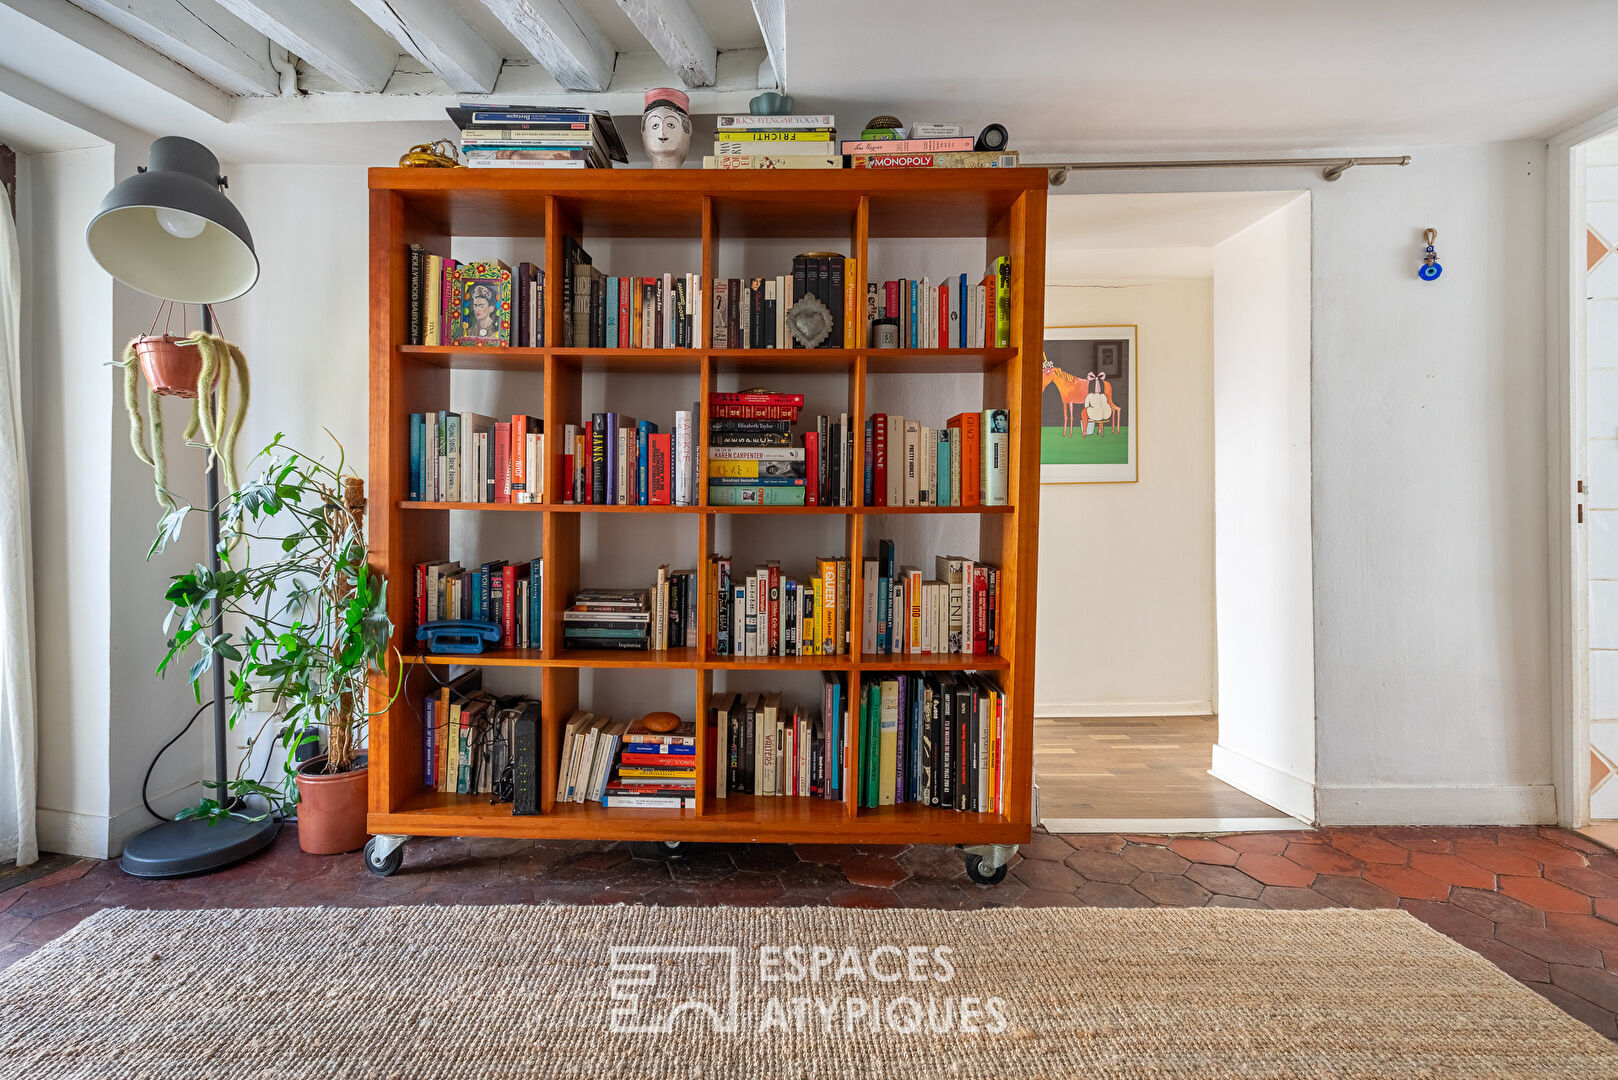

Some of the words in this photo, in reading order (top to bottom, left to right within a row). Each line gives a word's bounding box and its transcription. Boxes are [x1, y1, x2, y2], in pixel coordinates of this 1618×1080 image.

[875, 156, 931, 166] MONOPOLY
[411, 252, 419, 301] HOLLYWOOD
[678, 283, 686, 305] DAMAGED
[411, 302, 419, 336] BABYLON
[678, 302, 686, 320] GOODS
[868, 296, 878, 321] edie
[682, 416, 691, 462] JACKIE
[738, 422, 758, 431] Elizabeth
[760, 422, 774, 431] Taylor
[593, 432, 604, 462] JANIS
[515, 461, 523, 478] JOHN
[826, 571, 835, 608] QUEEN
[482, 601, 488, 610] ME
[912, 606, 920, 618] OUI
[951, 588, 962, 622] LENI
[764, 734, 772, 766] WALTERS
[980, 728, 990, 754] London
[980, 757, 990, 769] Jack
